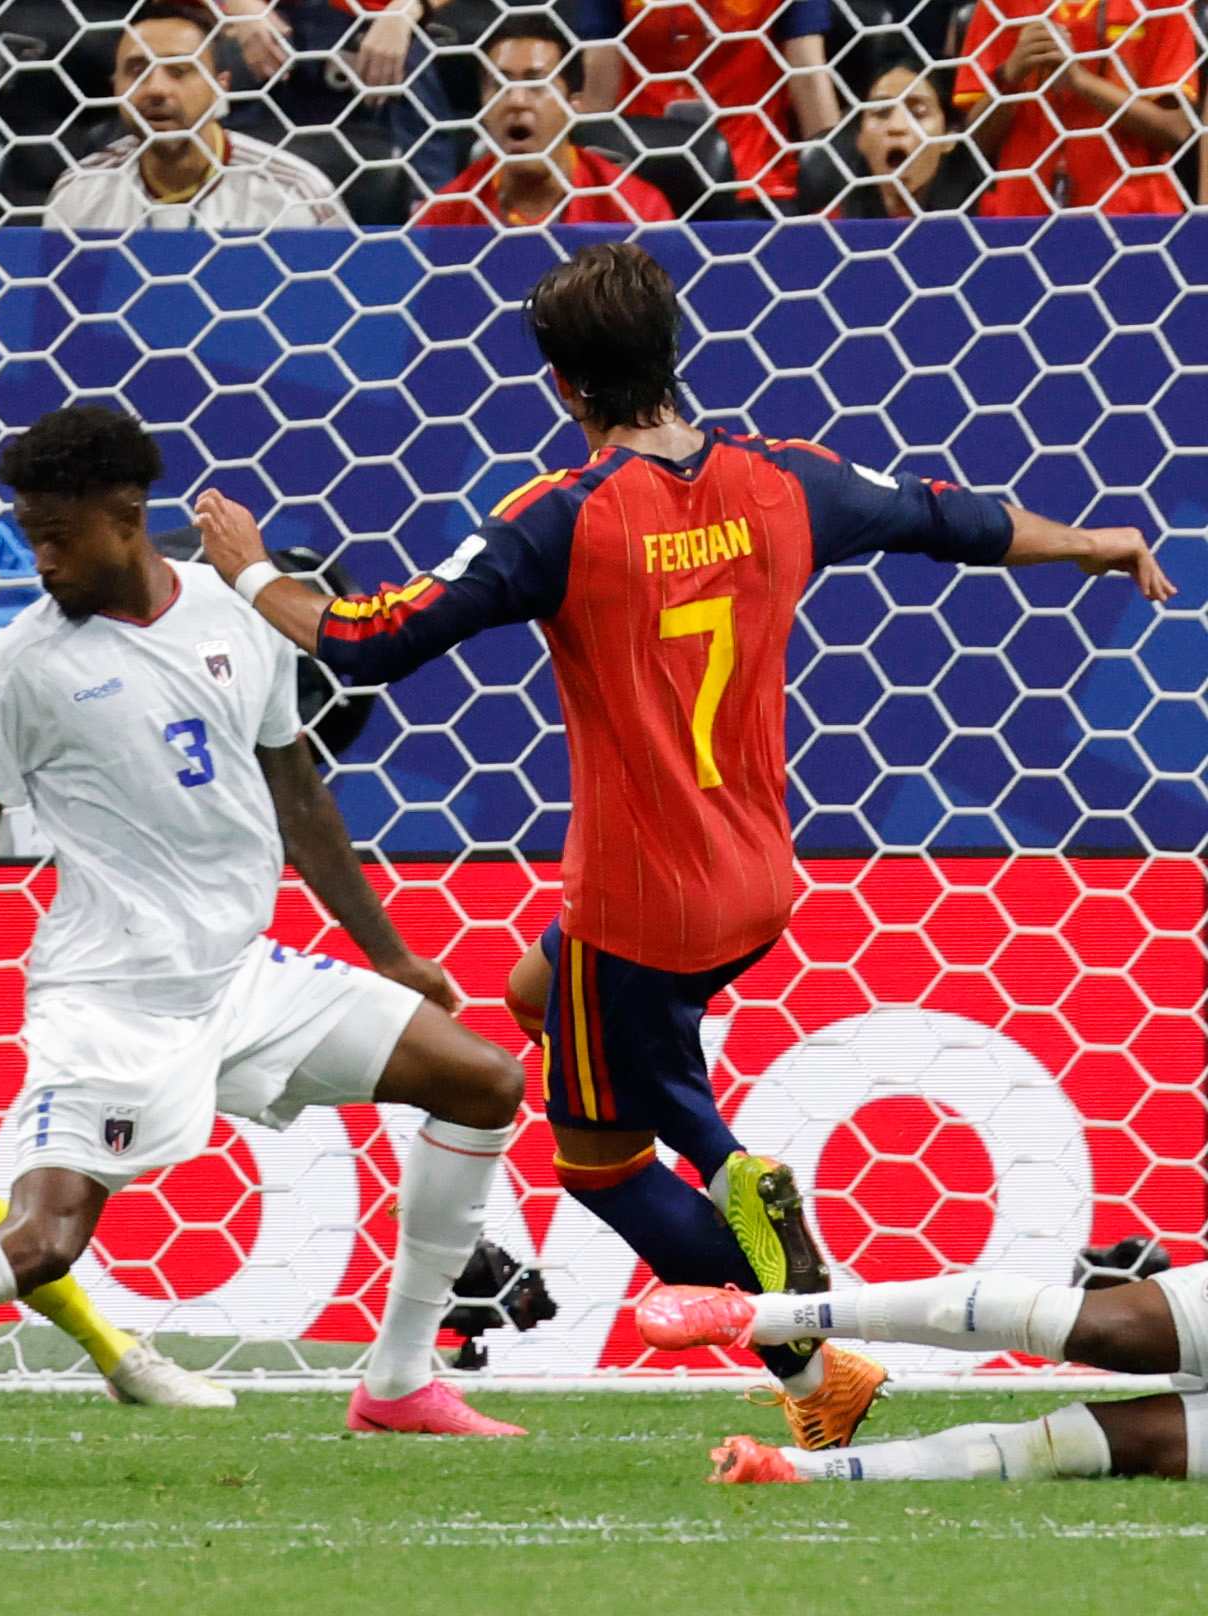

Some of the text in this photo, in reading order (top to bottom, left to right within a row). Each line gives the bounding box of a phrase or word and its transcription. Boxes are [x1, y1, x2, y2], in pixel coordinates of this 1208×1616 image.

[642, 517, 752, 574] FERRAN
[659, 596, 735, 789] 7
[164, 718, 215, 788] 3
